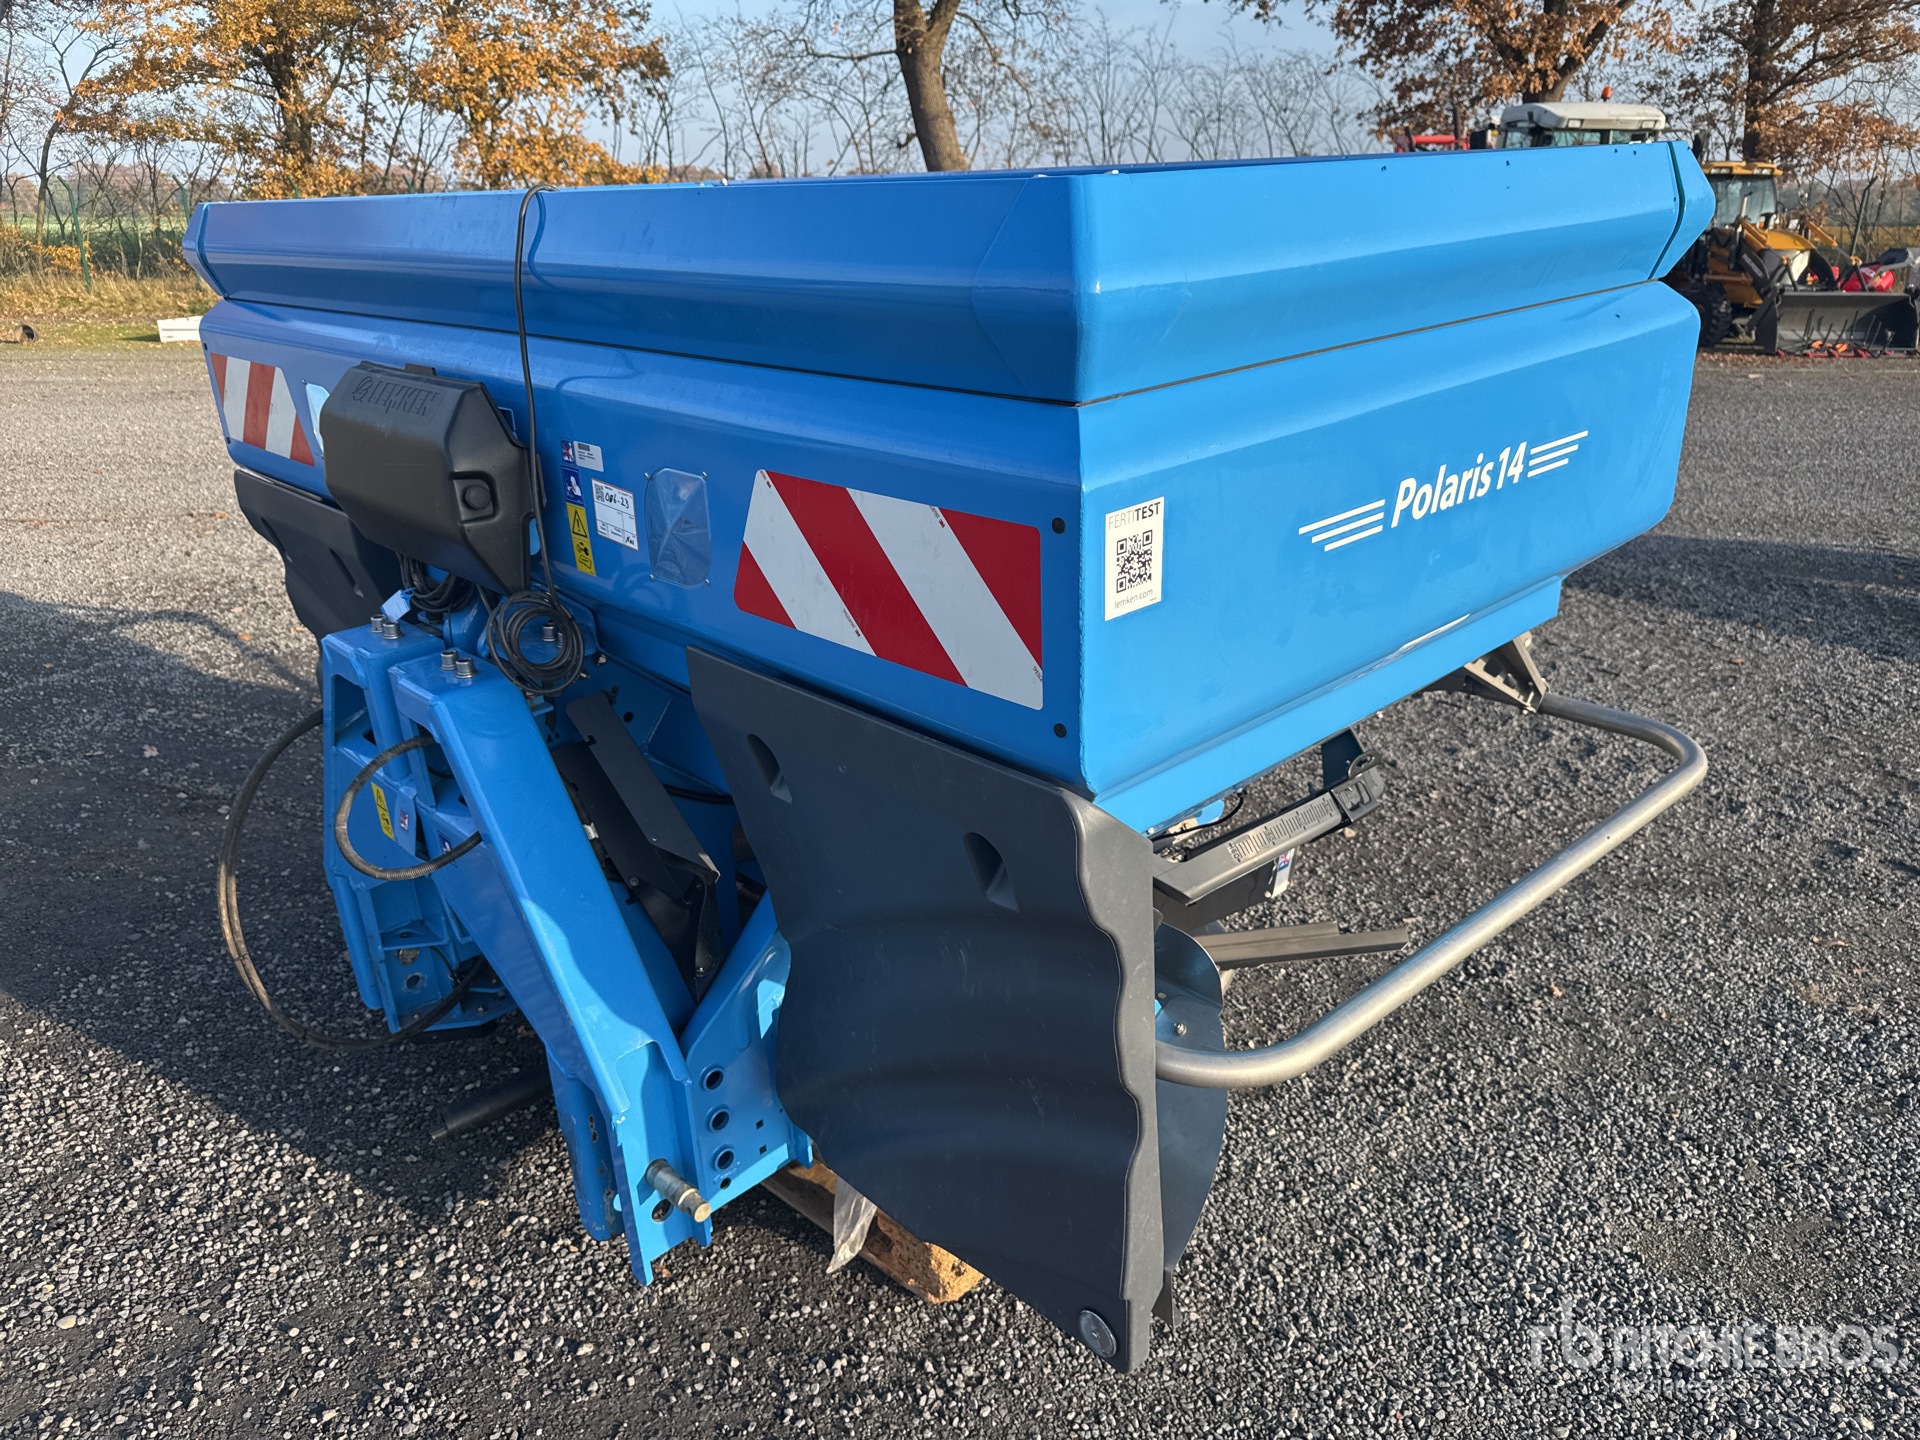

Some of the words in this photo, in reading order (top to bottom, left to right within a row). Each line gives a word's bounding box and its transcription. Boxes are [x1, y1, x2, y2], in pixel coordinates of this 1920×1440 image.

[367, 380, 440, 417] LEMKEN
[1391, 452, 1494, 528] Polaris
[1496, 441, 1527, 490] 14
[1108, 501, 1161, 530] FERTITEST
[1114, 588, 1153, 609] lemken.com
